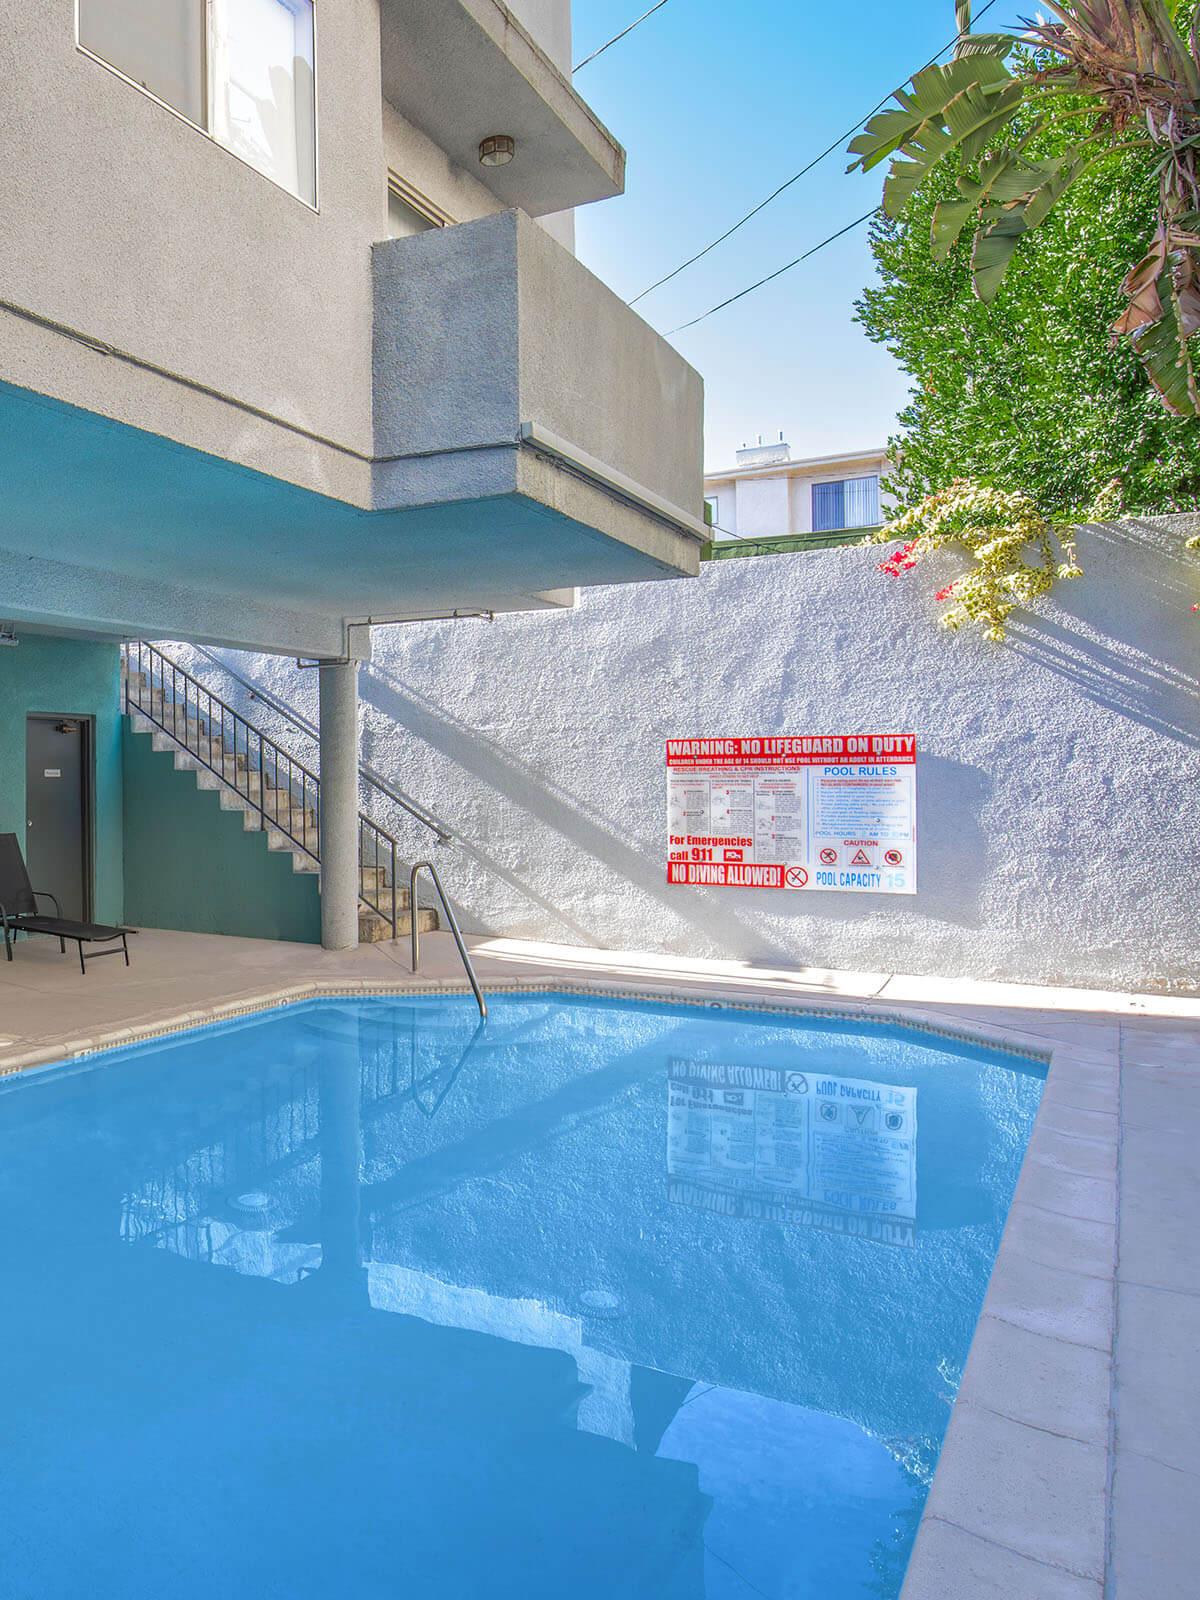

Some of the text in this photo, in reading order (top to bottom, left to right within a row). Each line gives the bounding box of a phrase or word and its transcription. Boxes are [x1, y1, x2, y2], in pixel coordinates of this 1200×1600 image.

[668, 736, 914, 755] WARNING: NO LIFEGUARD ON DUTY
[824, 766, 897, 776] POOL RULES
[670, 835, 752, 847] For Emergencies
[670, 848, 712, 861] call 911
[672, 864, 781, 887] NO DIVING ALLOWED!
[816, 872, 905, 888] POOL CAPACITY 15
